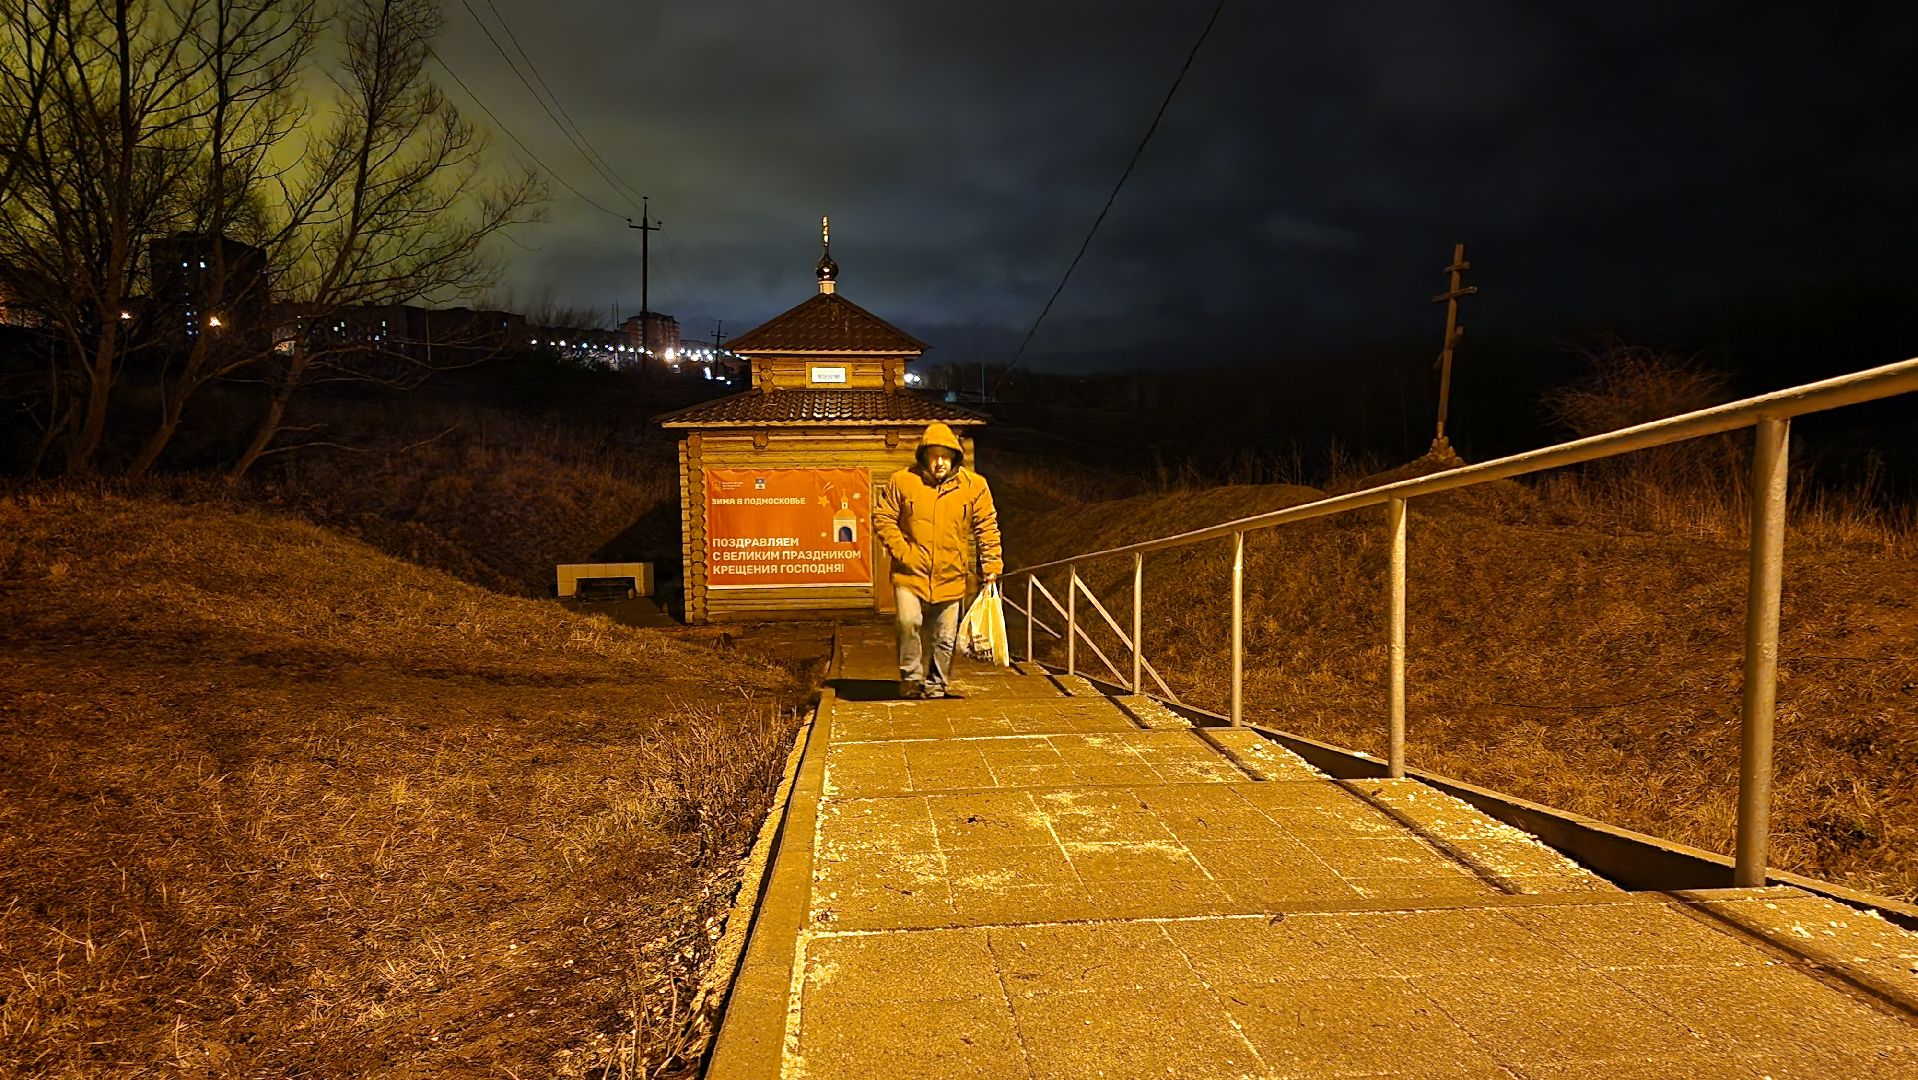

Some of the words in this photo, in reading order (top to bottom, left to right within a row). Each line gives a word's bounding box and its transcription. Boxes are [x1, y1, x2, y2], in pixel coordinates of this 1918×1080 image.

[744, 497, 806, 506] ПОДМОСКОВЬЕ
[712, 537, 799, 549] ПОЗДРАВЛЯЕМ
[712, 551, 721, 561] С
[723, 551, 780, 561] ВЕЛИКИМ
[782, 550, 861, 561] ПРАЗДНИКОМ
[712, 565, 778, 576] КРЕЩЕНИЯ
[780, 563, 844, 574] ГОСПОДНЯ!
